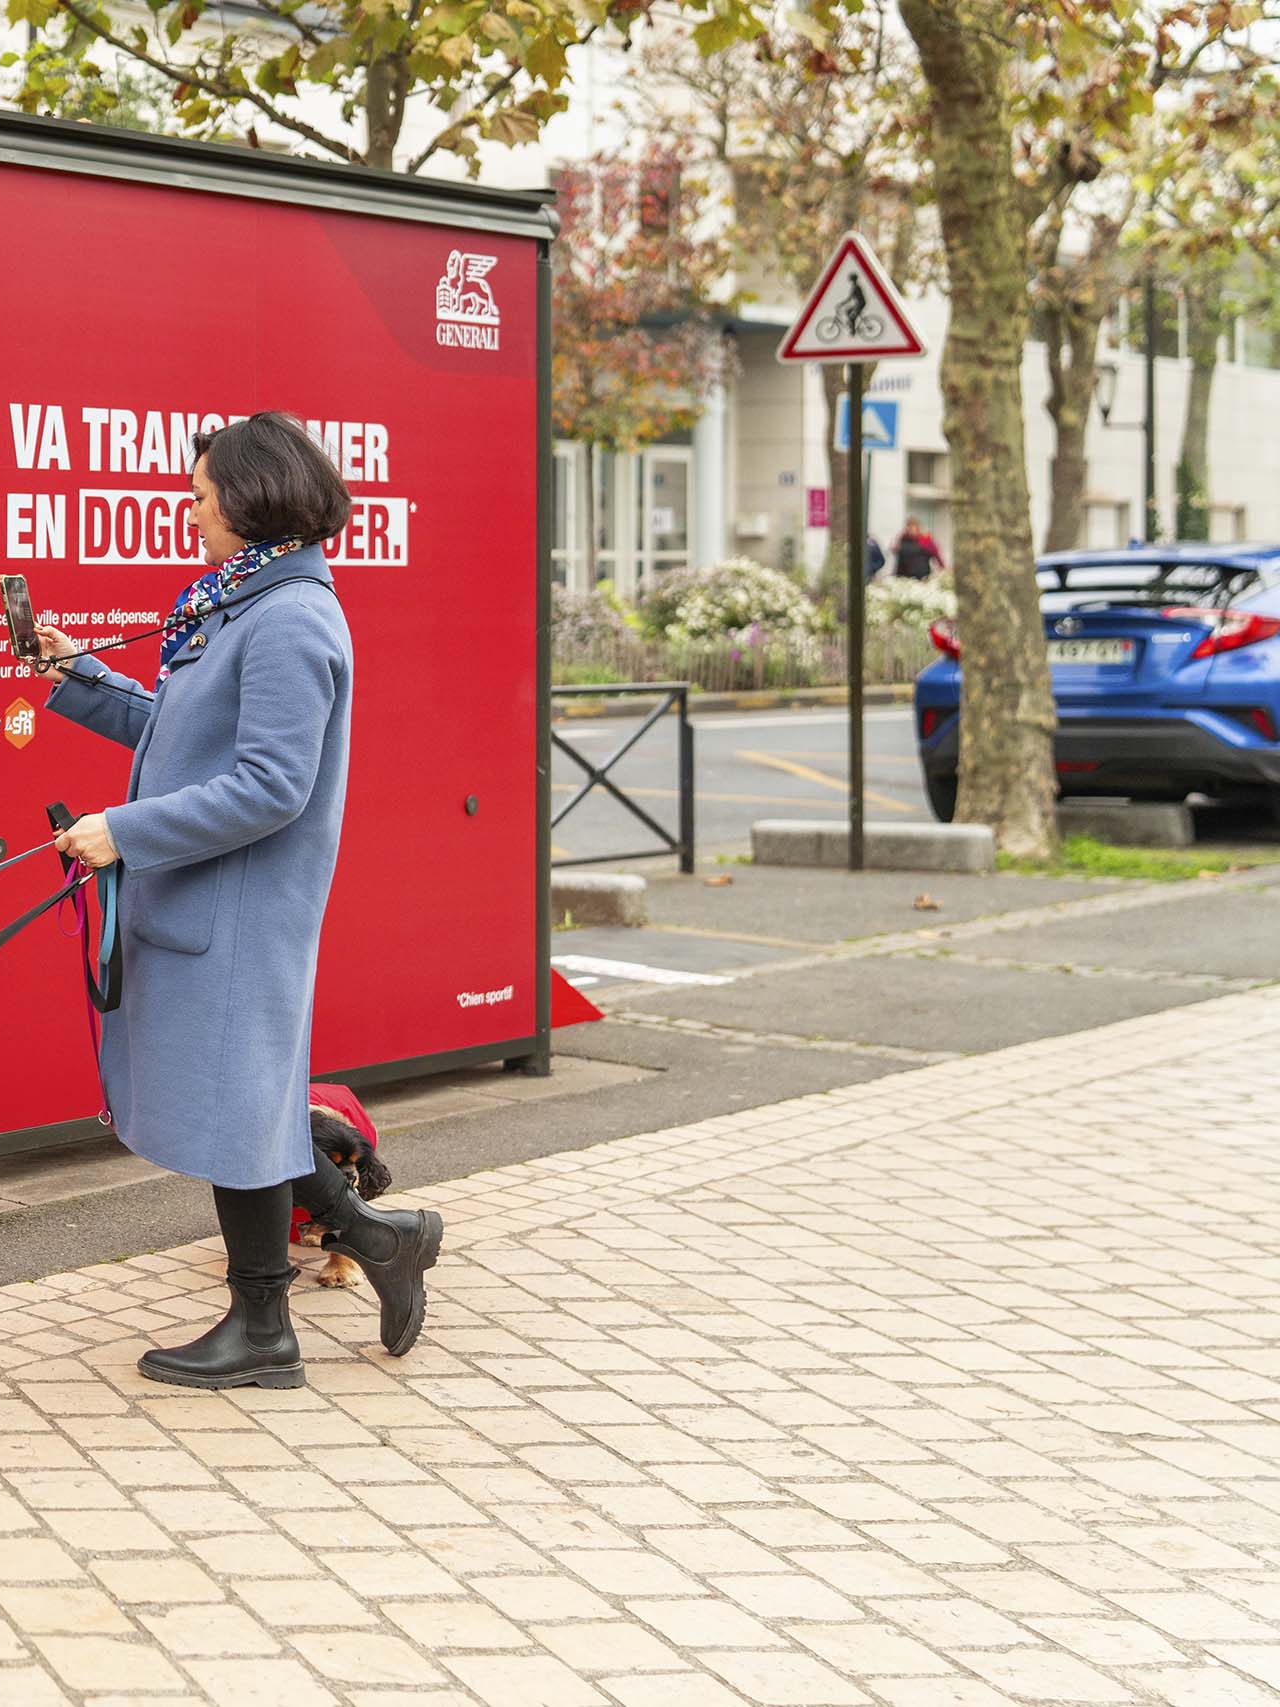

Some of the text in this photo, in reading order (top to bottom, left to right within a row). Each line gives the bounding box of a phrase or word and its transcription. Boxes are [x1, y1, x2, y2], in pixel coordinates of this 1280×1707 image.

[436, 323, 500, 351] GENERALI
[10, 403, 71, 470] VA
[7, 493, 66, 559] EN
[36, 609, 59, 625] ville
[62, 613, 89, 628] pour
[91, 612, 105, 624] se
[107, 609, 160, 627] dépenser,
[15, 664, 31, 678] de
[485, 985, 513, 1007] sportif
